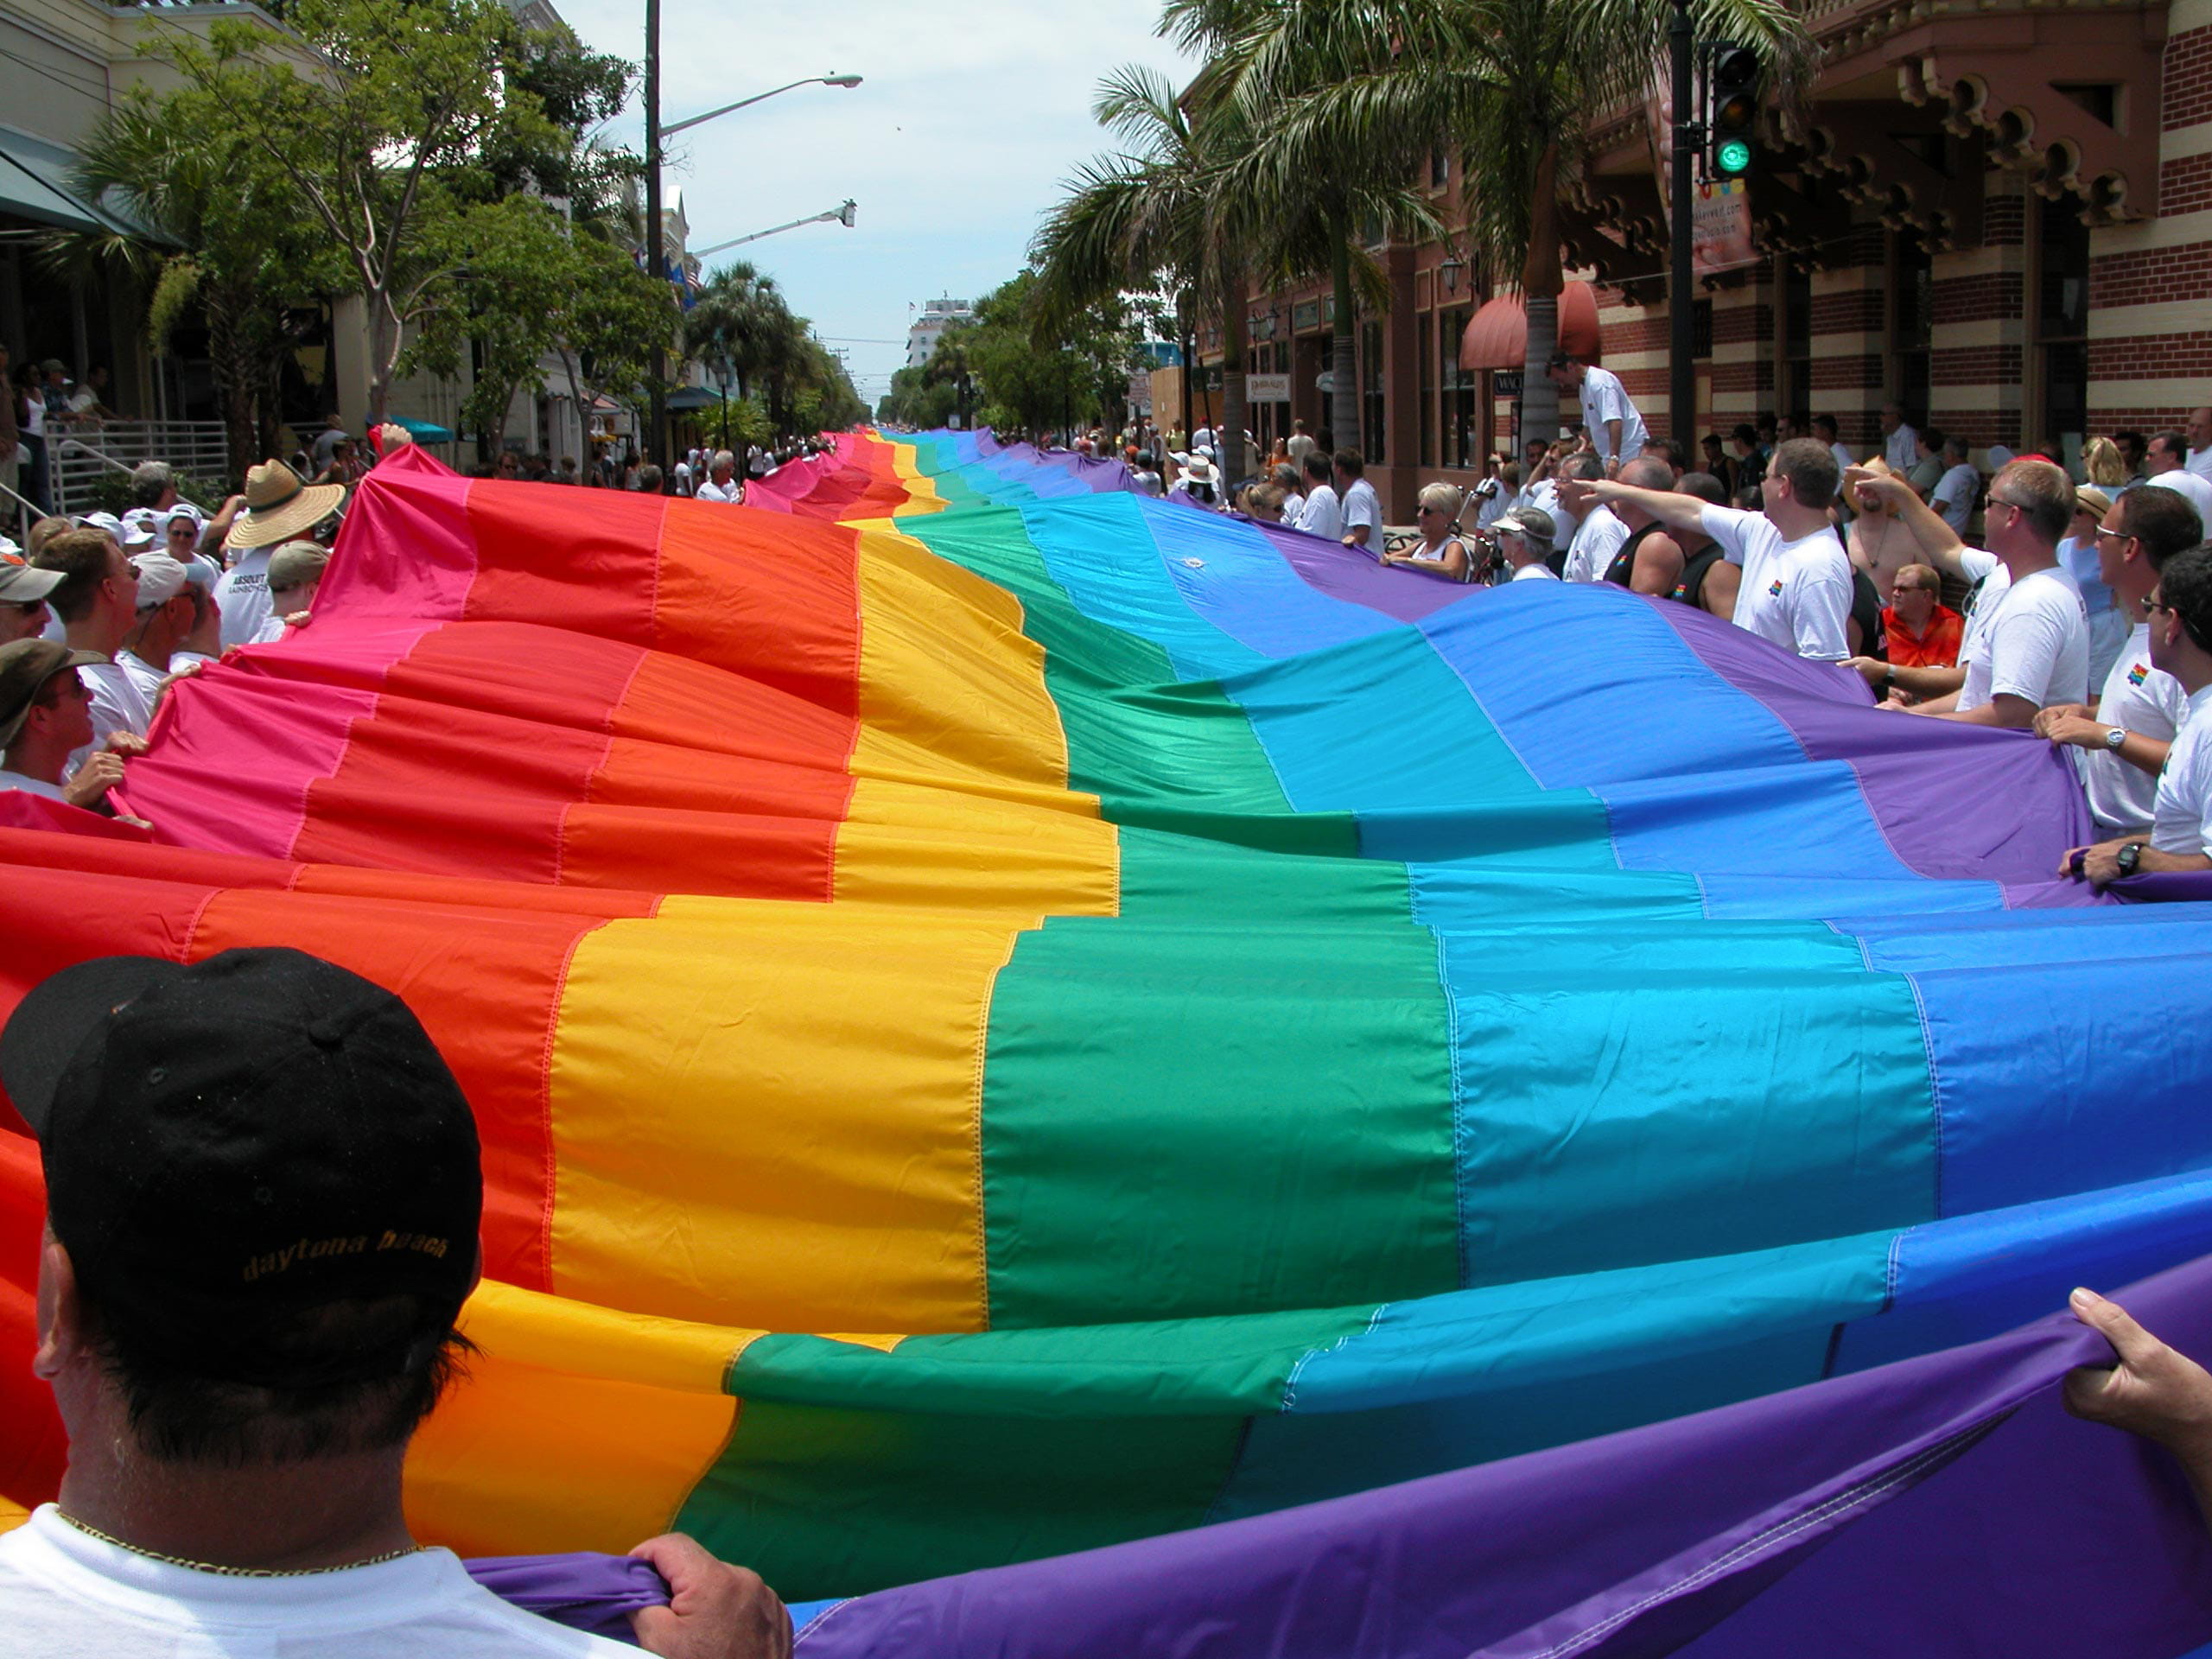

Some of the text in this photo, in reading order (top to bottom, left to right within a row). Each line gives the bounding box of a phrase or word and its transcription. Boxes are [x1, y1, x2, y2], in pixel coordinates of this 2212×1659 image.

[234, 574, 266, 585] ABSOLUT
[243, 1229, 450, 1282] daytona beach
